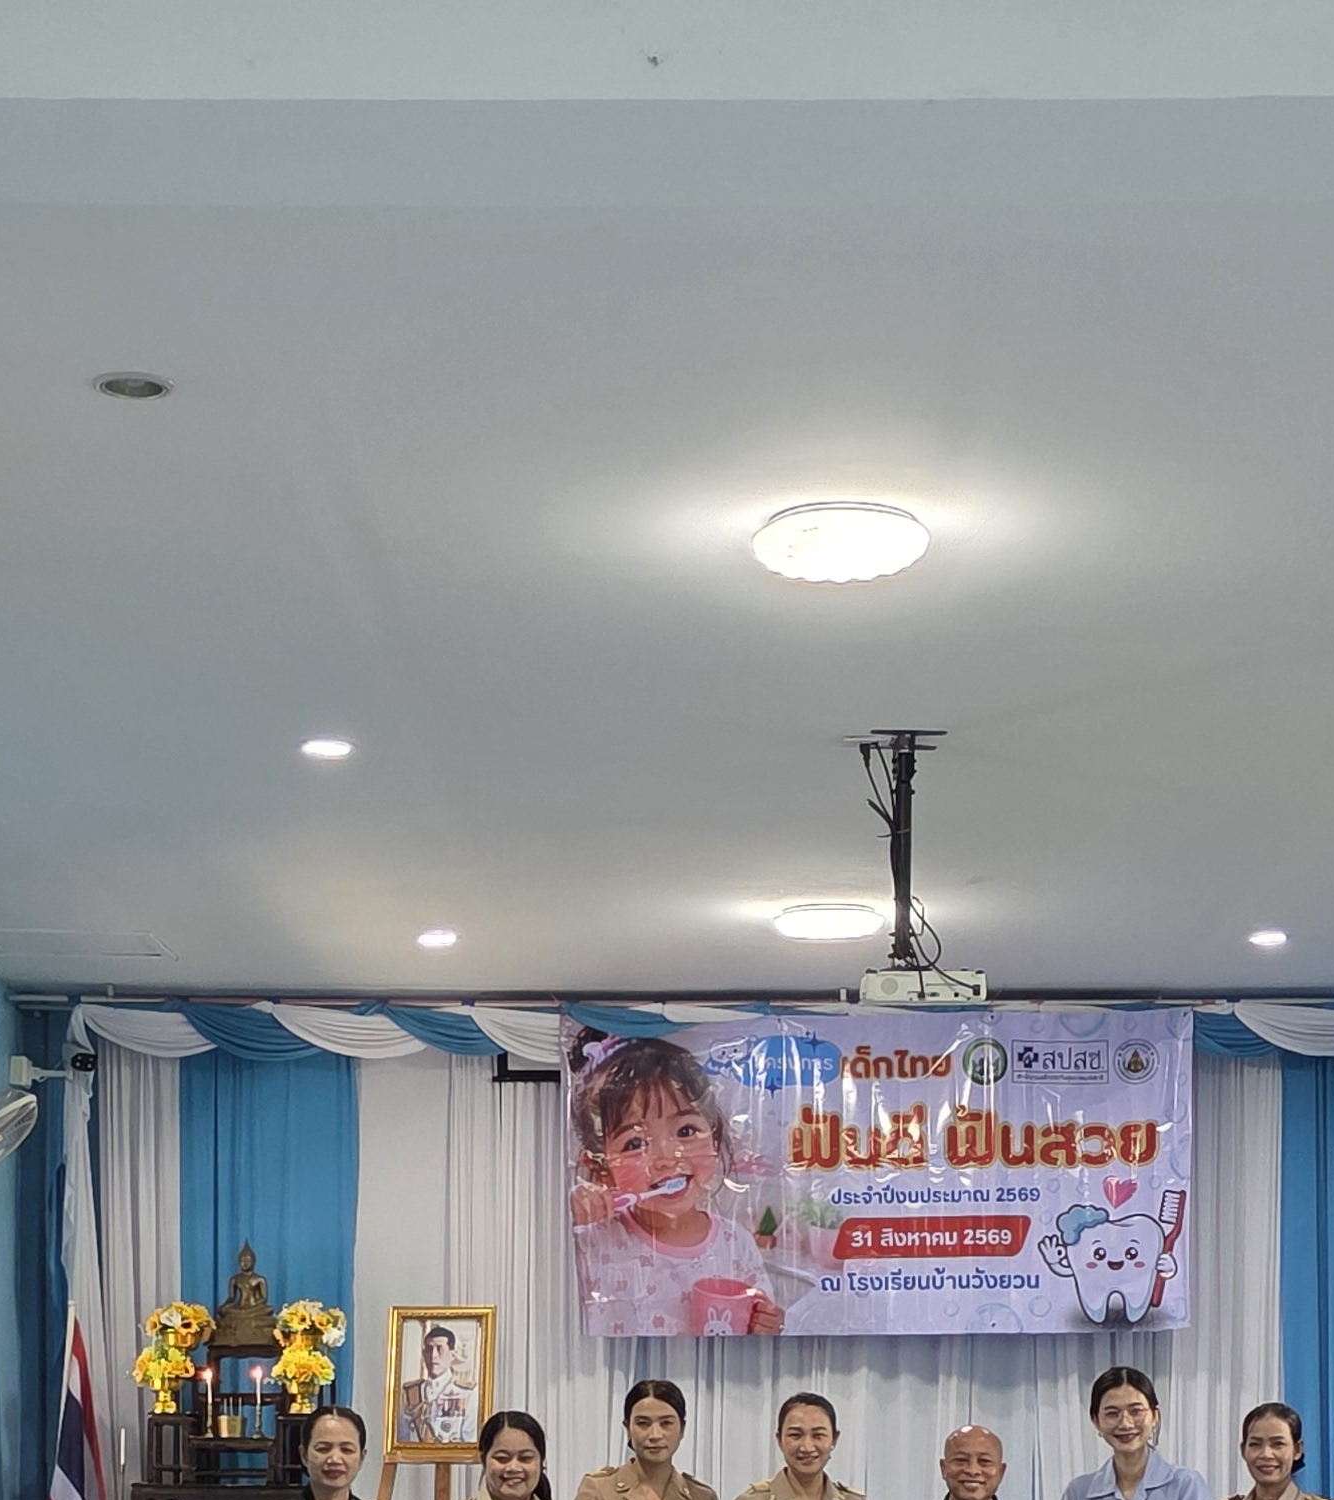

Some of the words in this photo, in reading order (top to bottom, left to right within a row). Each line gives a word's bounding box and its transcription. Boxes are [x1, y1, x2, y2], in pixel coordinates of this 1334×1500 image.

[755, 1054, 834, 1072] ครงการ
[841, 1045, 952, 1080] เด็กไทย
[1042, 1046, 1105, 1070] สปสช.
[790, 1102, 927, 1169] ฟันดี
[946, 1104, 1158, 1167] ฟันสวย
[830, 1185, 990, 1205] ประจำปีงบประมาณ
[996, 1187, 1041, 1203] 2569
[850, 1230, 873, 1248] 31
[880, 1227, 959, 1248] สิงหาคม
[963, 1229, 1013, 1246] 2569
[820, 1276, 841, 1292] ณ
[847, 1267, 1041, 1292] โรงเรียนบ้านวังยวน
